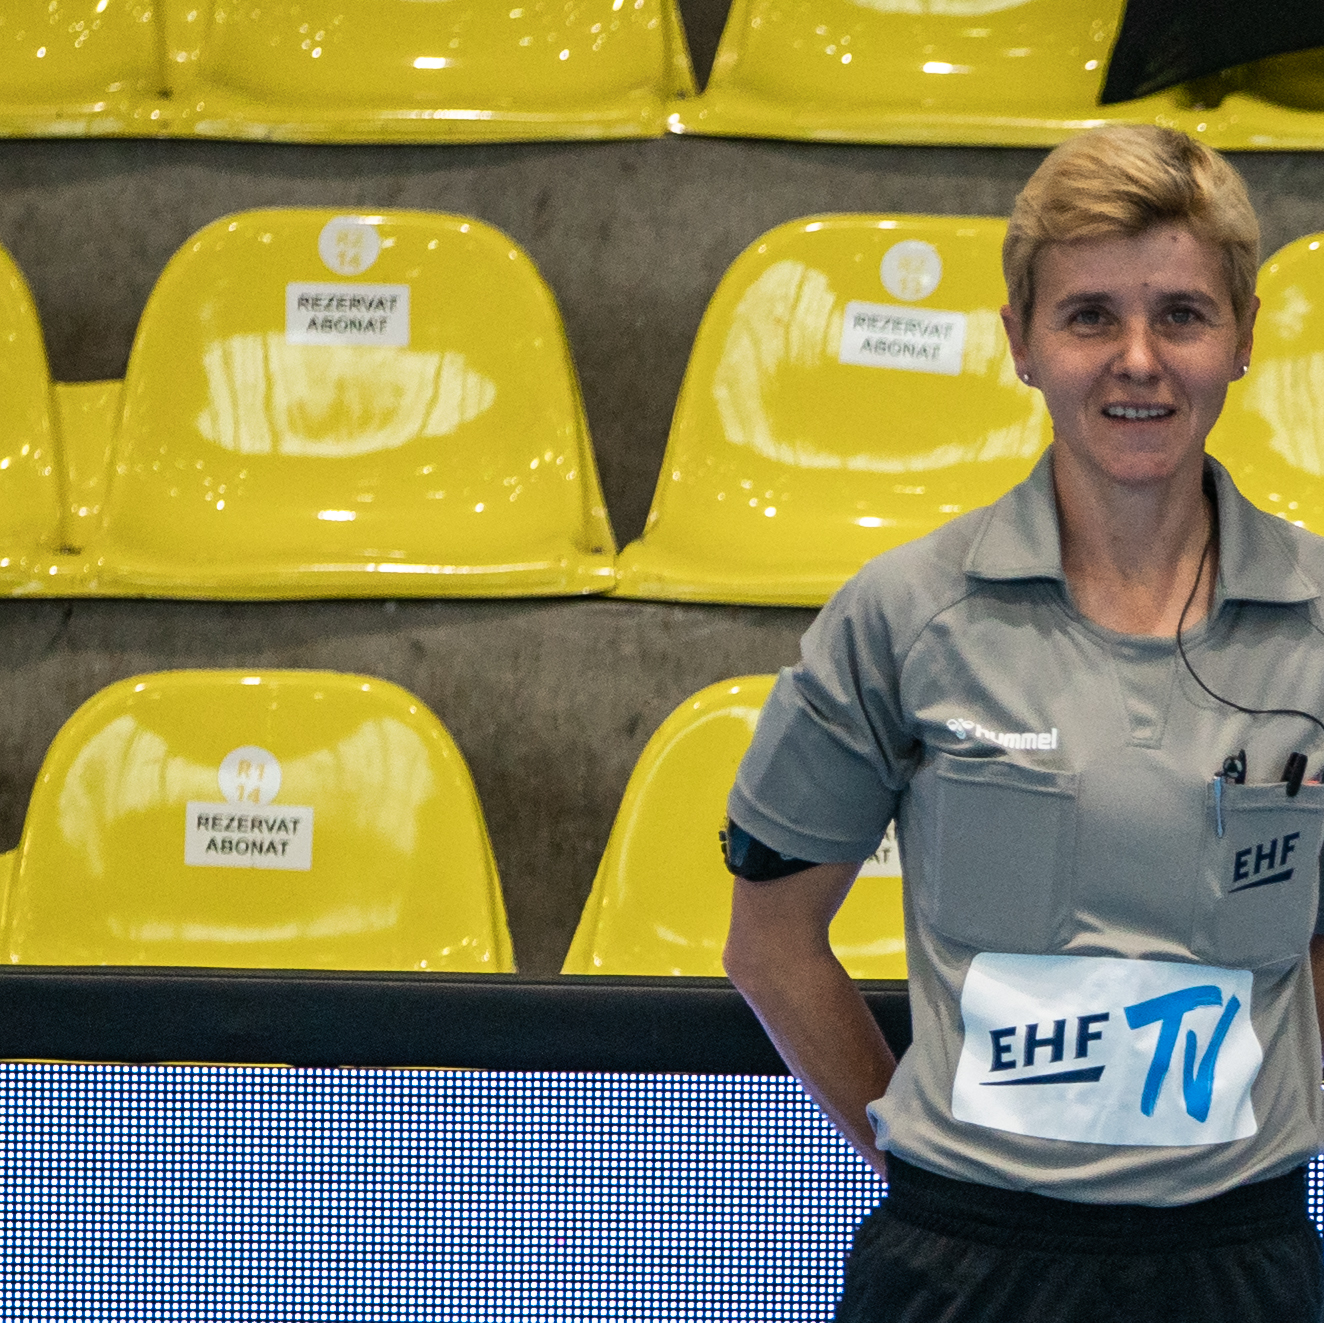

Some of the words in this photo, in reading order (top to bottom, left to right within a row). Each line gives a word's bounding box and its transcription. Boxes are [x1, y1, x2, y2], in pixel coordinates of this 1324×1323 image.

[297, 292, 398, 313] REZERVAT
[306, 314, 388, 334] ABONAT
[853, 310, 955, 340] REZERVAT
[860, 336, 943, 361] ABONAT
[975, 724, 1059, 750] hummel
[196, 812, 301, 836] REZERVAT
[205, 835, 290, 857] ABONAT
[1233, 831, 1301, 883] EHF
[988, 1011, 1110, 1073] EHF
[1123, 984, 1241, 1124] TV
